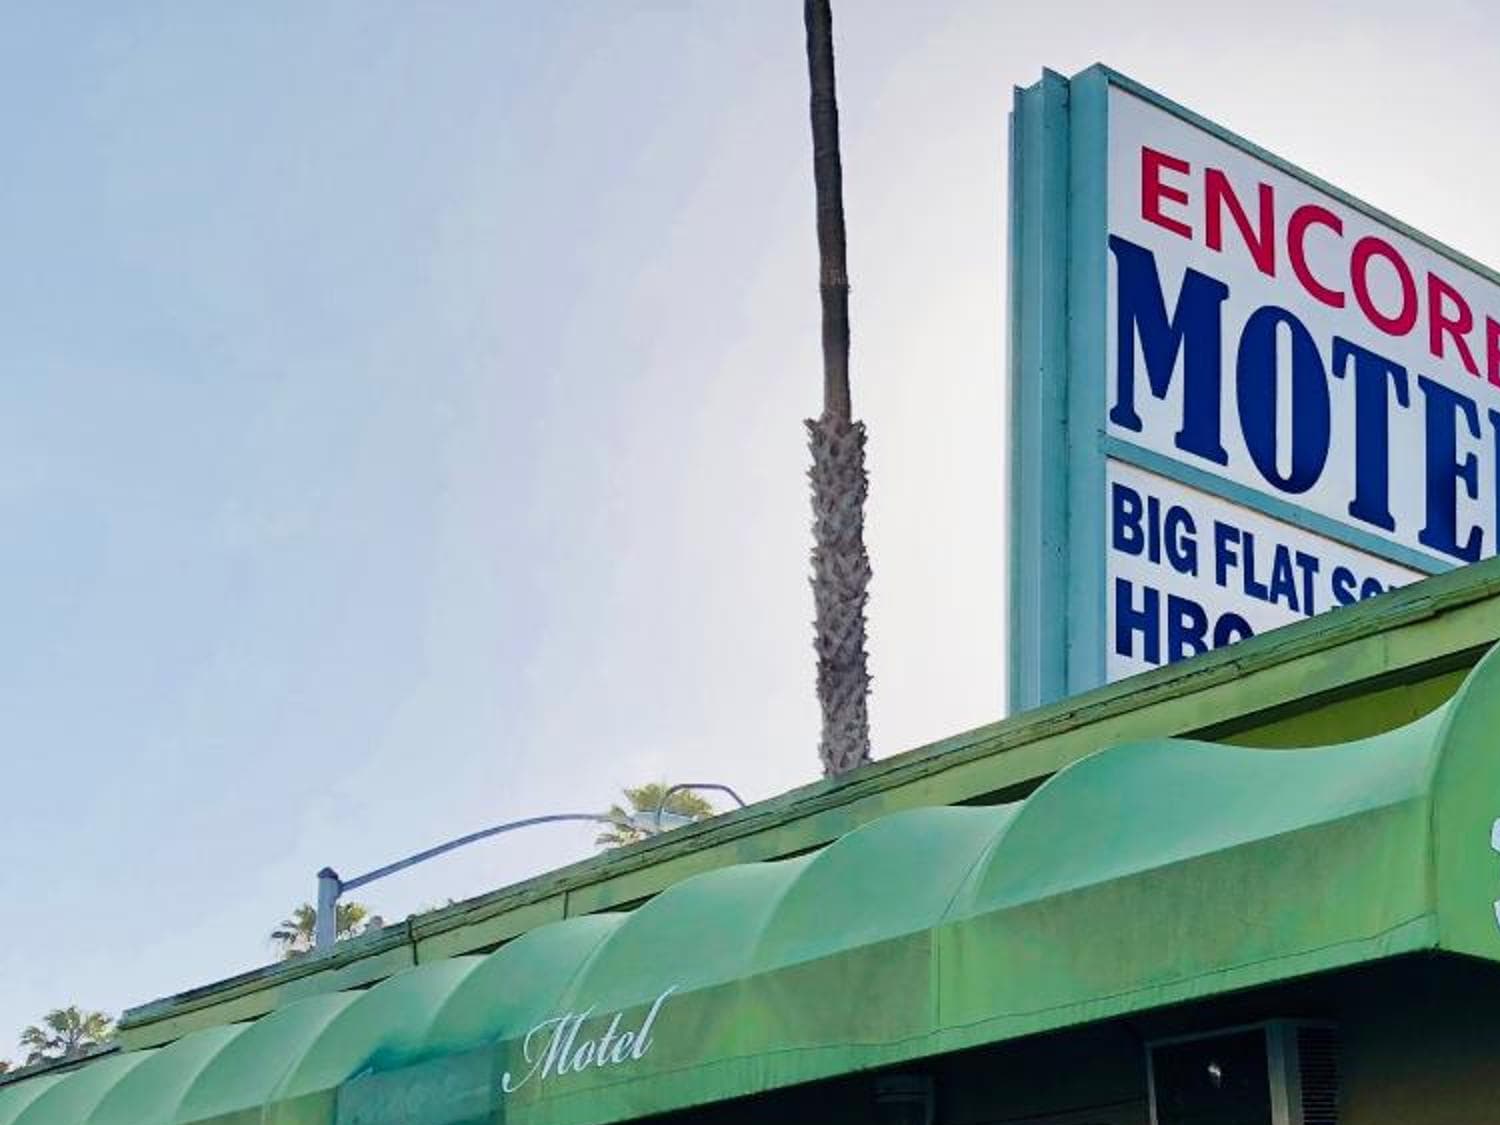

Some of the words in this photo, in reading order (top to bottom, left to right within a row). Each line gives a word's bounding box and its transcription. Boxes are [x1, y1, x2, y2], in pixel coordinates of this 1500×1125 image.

[1111, 481, 1198, 577] BIG
[1213, 519, 1320, 617] FLAT
[501, 984, 681, 1093] Motel
